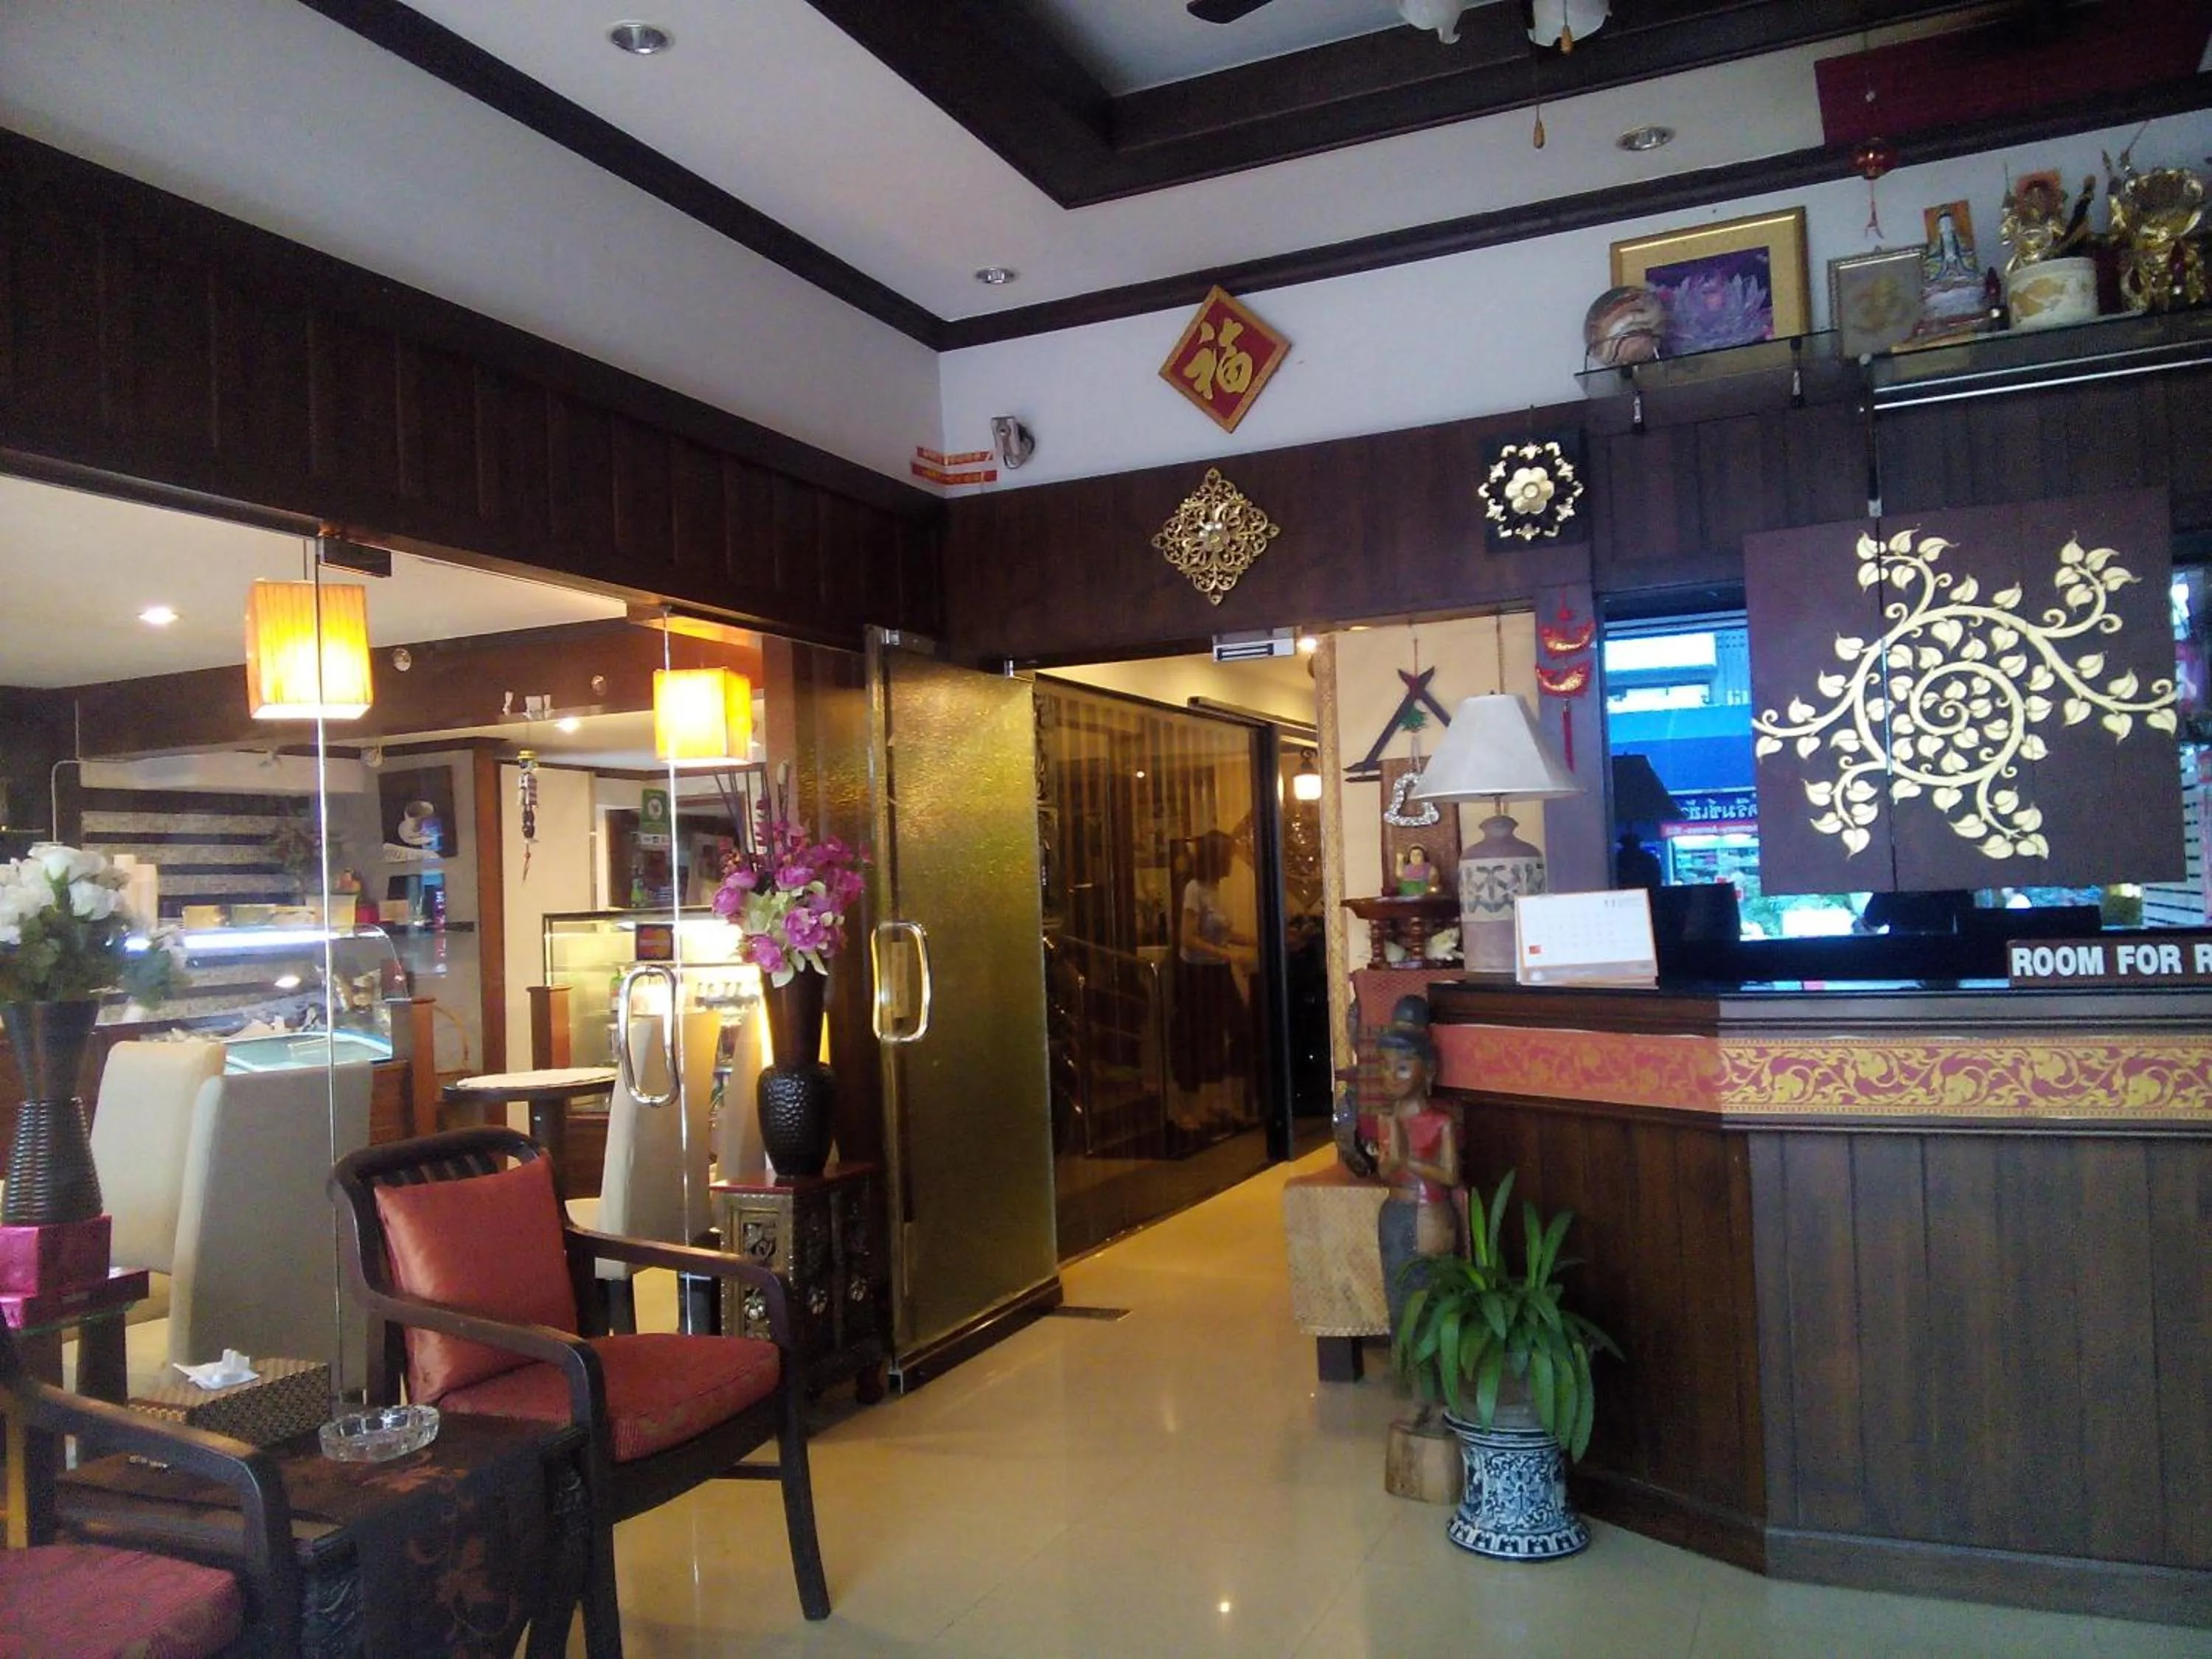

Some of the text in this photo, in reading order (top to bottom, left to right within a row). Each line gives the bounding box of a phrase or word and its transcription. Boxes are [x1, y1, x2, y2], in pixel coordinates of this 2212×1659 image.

[1183, 318, 1253, 400] 福
[2011, 947, 2104, 977] ROOM
[2116, 945, 2183, 975] FOR
